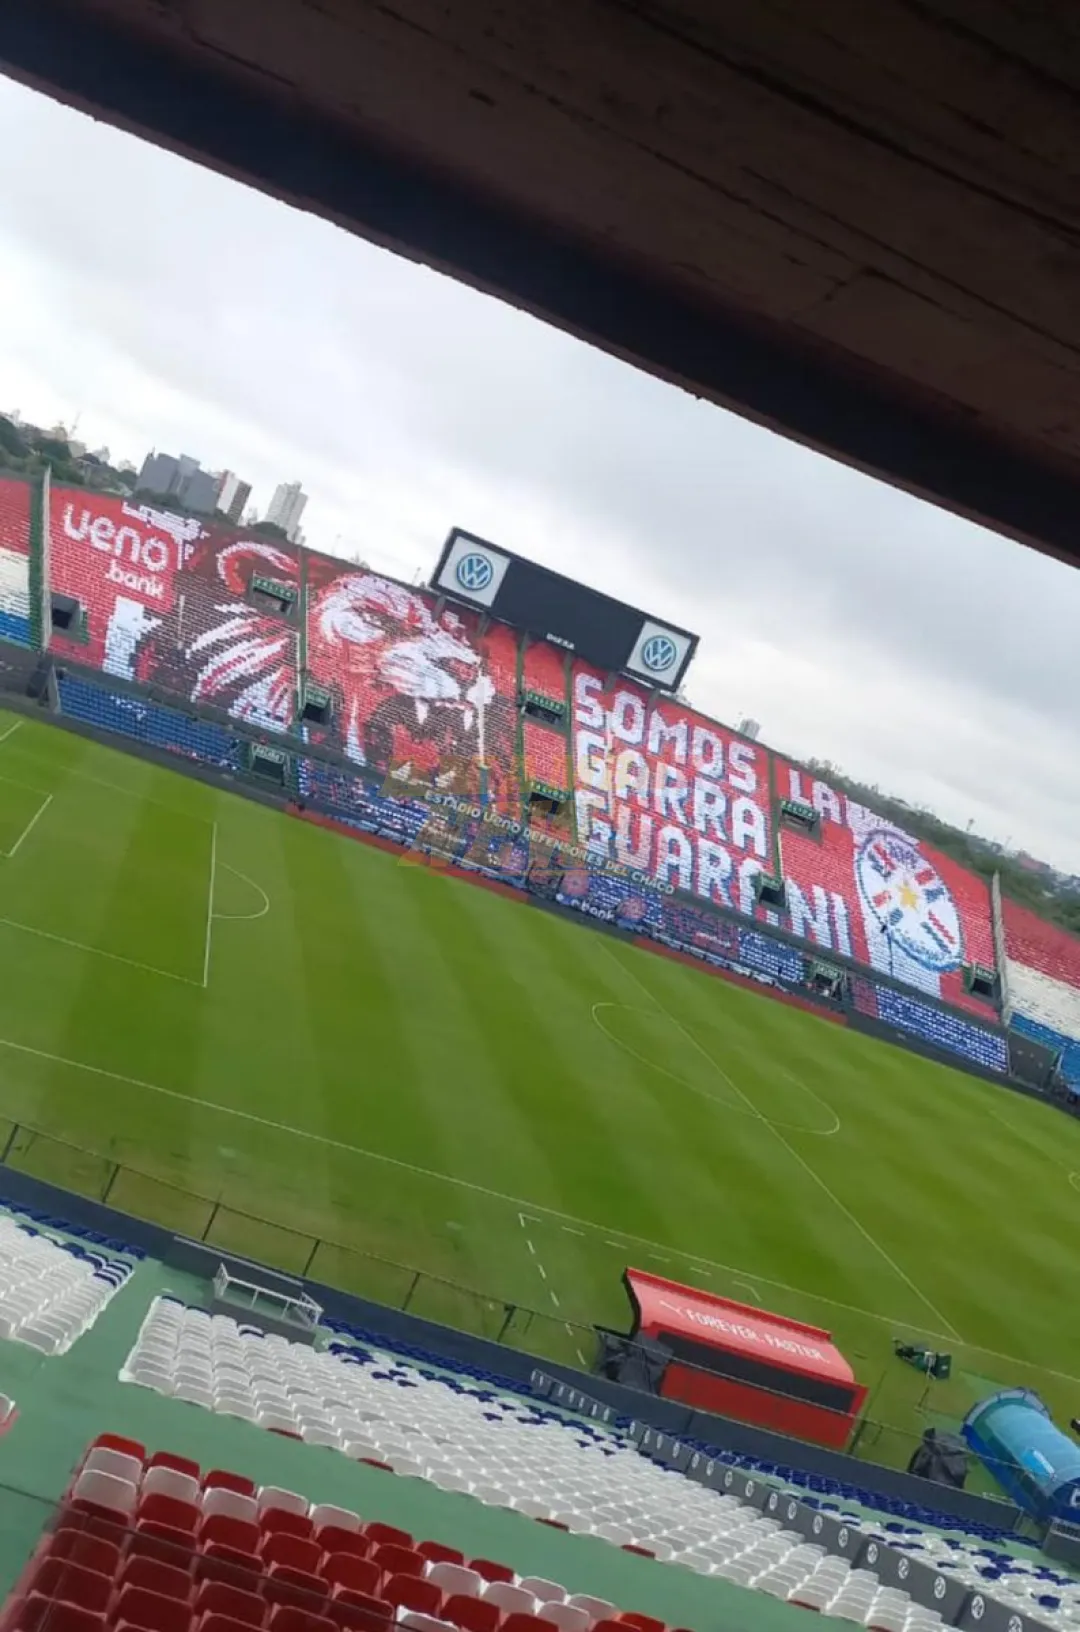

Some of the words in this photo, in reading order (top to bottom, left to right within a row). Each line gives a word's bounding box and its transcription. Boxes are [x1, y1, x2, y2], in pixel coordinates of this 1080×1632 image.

[63, 503, 169, 572] ueno
[106, 560, 164, 599] bank
[575, 672, 757, 792] SOMOS
[789, 769, 842, 825] LA
[576, 730, 767, 857] GARRA
[521, 826, 603, 867] DEFENSORES
[605, 859, 629, 877] DEL
[630, 871, 675, 896] CHACO
